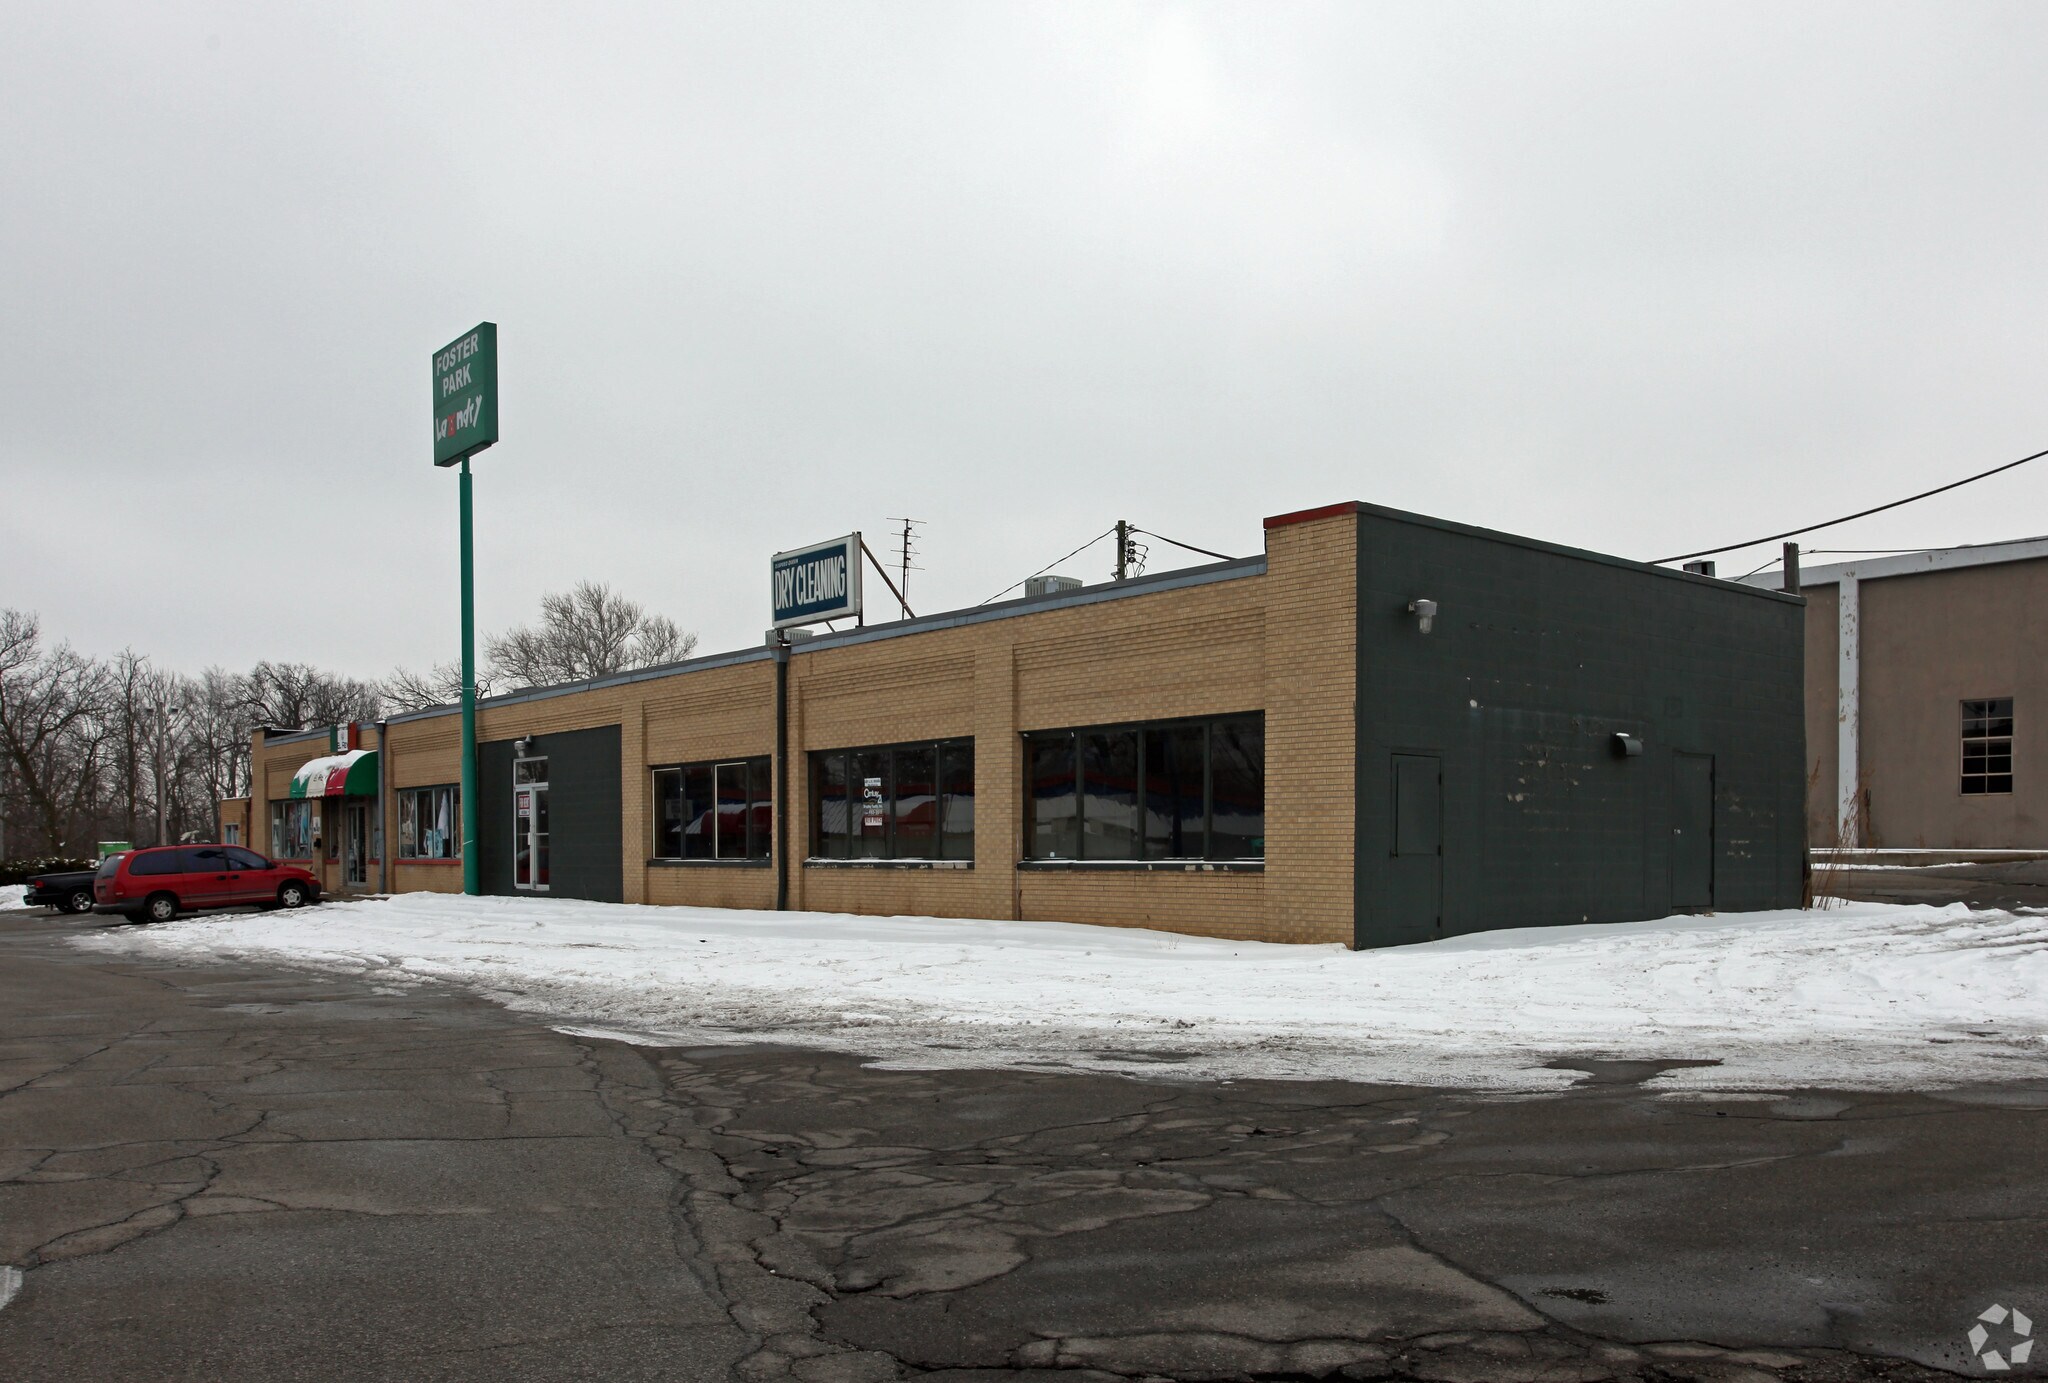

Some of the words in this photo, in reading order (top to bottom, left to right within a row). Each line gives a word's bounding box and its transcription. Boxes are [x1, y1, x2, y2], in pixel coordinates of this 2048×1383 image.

[437, 333, 479, 376] FOSTER
[443, 363, 472, 397] PARK
[775, 567, 795, 610] DRY
[796, 555, 845, 605] CLEANING
